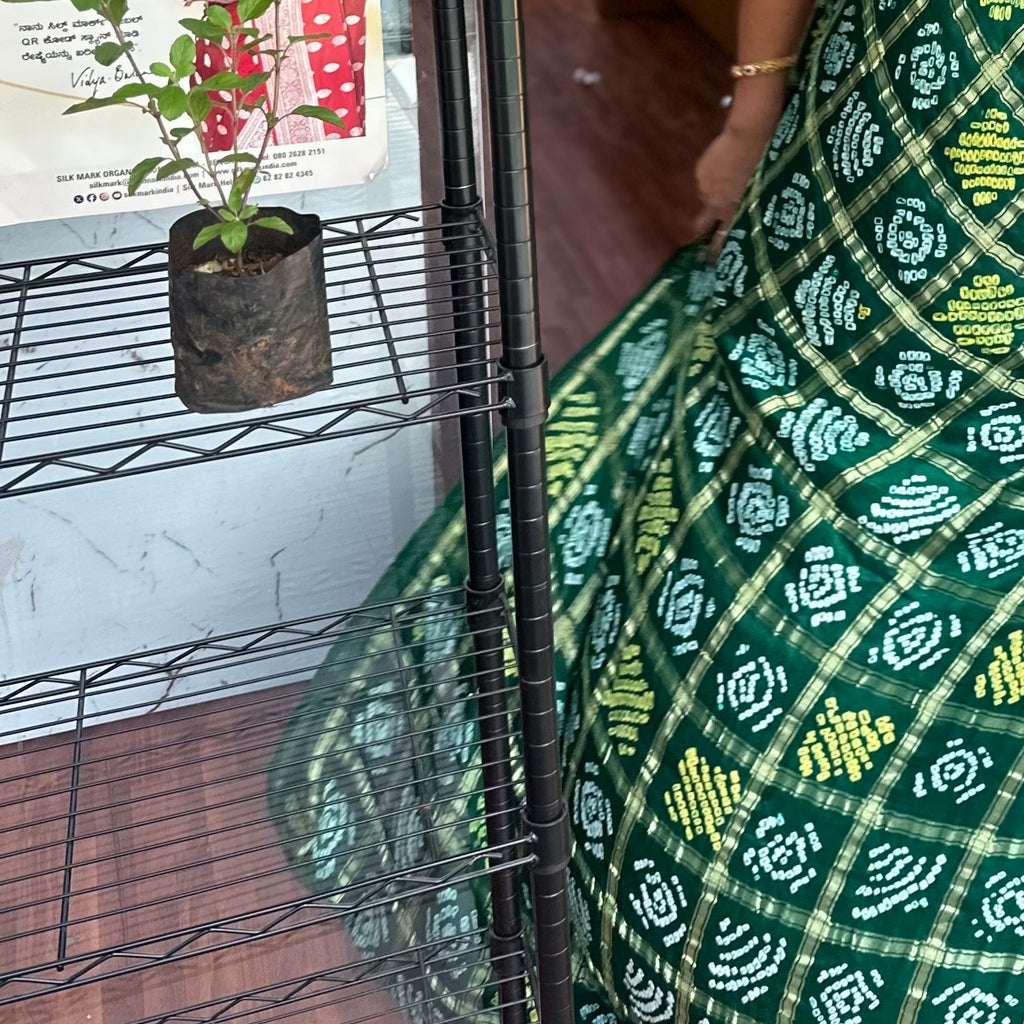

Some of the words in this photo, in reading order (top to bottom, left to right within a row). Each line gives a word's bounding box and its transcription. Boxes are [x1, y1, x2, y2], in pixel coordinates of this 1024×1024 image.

[21, 37, 39, 46] QR
[56, 174, 75, 183] SILK
[76, 171, 101, 181] MARK
[308, 148, 326, 156] 2151
